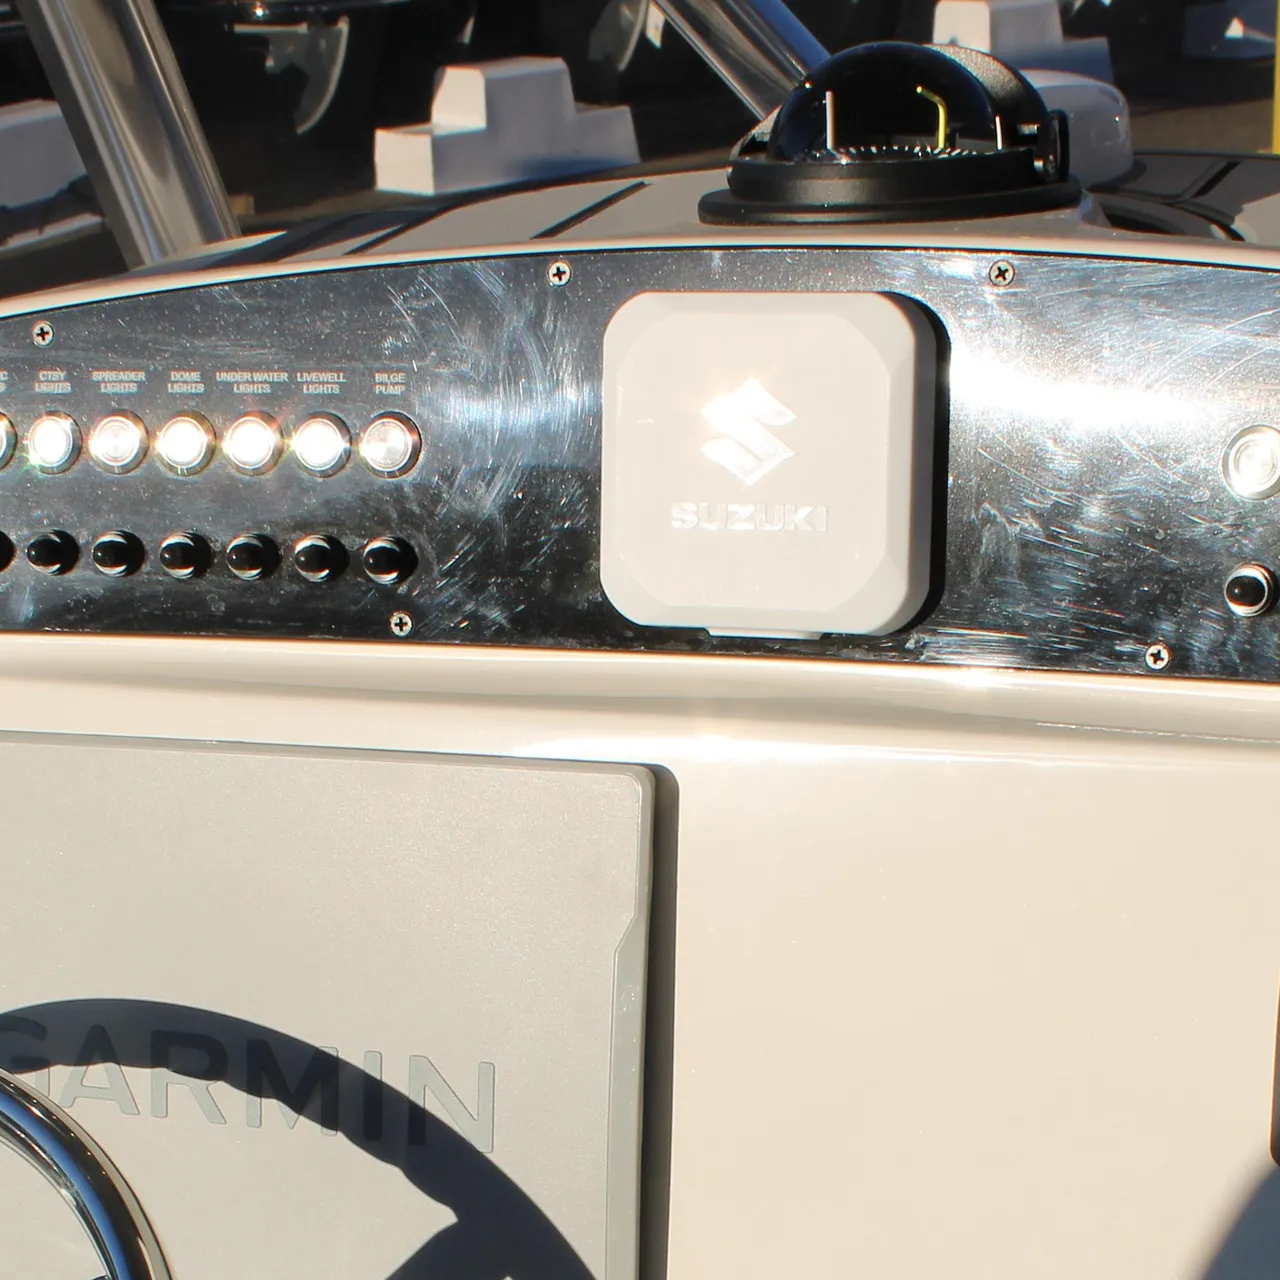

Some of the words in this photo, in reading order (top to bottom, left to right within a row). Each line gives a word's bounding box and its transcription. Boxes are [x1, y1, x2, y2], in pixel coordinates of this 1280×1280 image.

[39, 371, 66, 382] CTSY
[92, 371, 146, 382] SPREADER
[170, 371, 201, 382] DOME
[297, 372, 347, 383] LIVEWELL
[375, 372, 406, 383] BILGE
[101, 382, 138, 394] LIGHTS
[167, 382, 205, 394] LIGHTS
[233, 382, 271, 394] LIGHTS
[303, 383, 340, 395] LIGHTS
[375, 384, 406, 396] PUMP
[671, 502, 829, 532] SUZUKI
